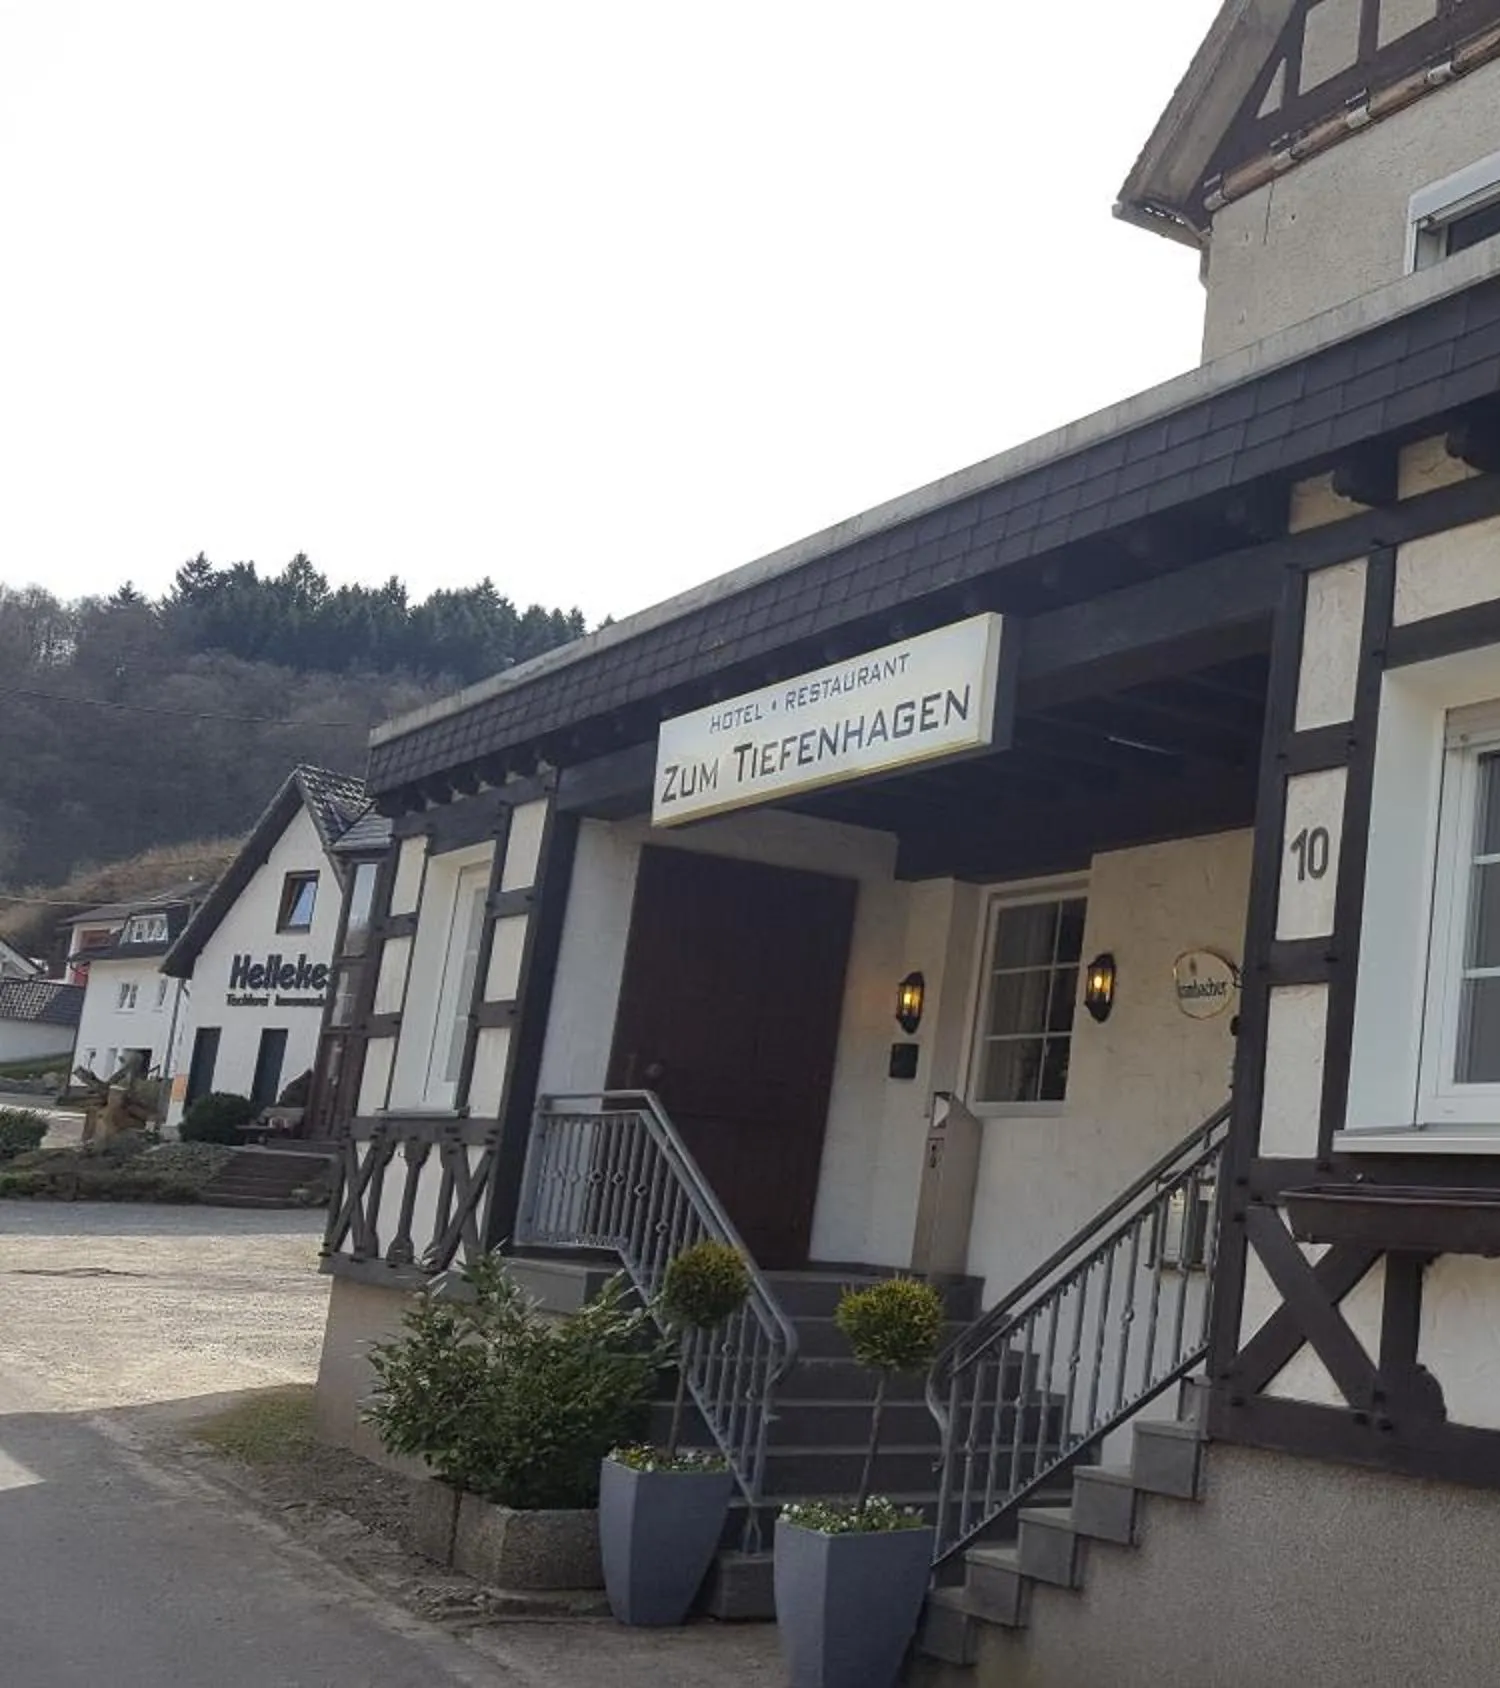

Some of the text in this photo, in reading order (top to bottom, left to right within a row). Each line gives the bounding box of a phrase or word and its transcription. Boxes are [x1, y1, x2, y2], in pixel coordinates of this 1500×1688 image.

[709, 652, 911, 734] HOTEL RESTAURANT
[661, 684, 971, 803] ZUM TIEFENHAGEN
[1290, 827, 1329, 880] 10
[229, 953, 332, 990] Helleke
